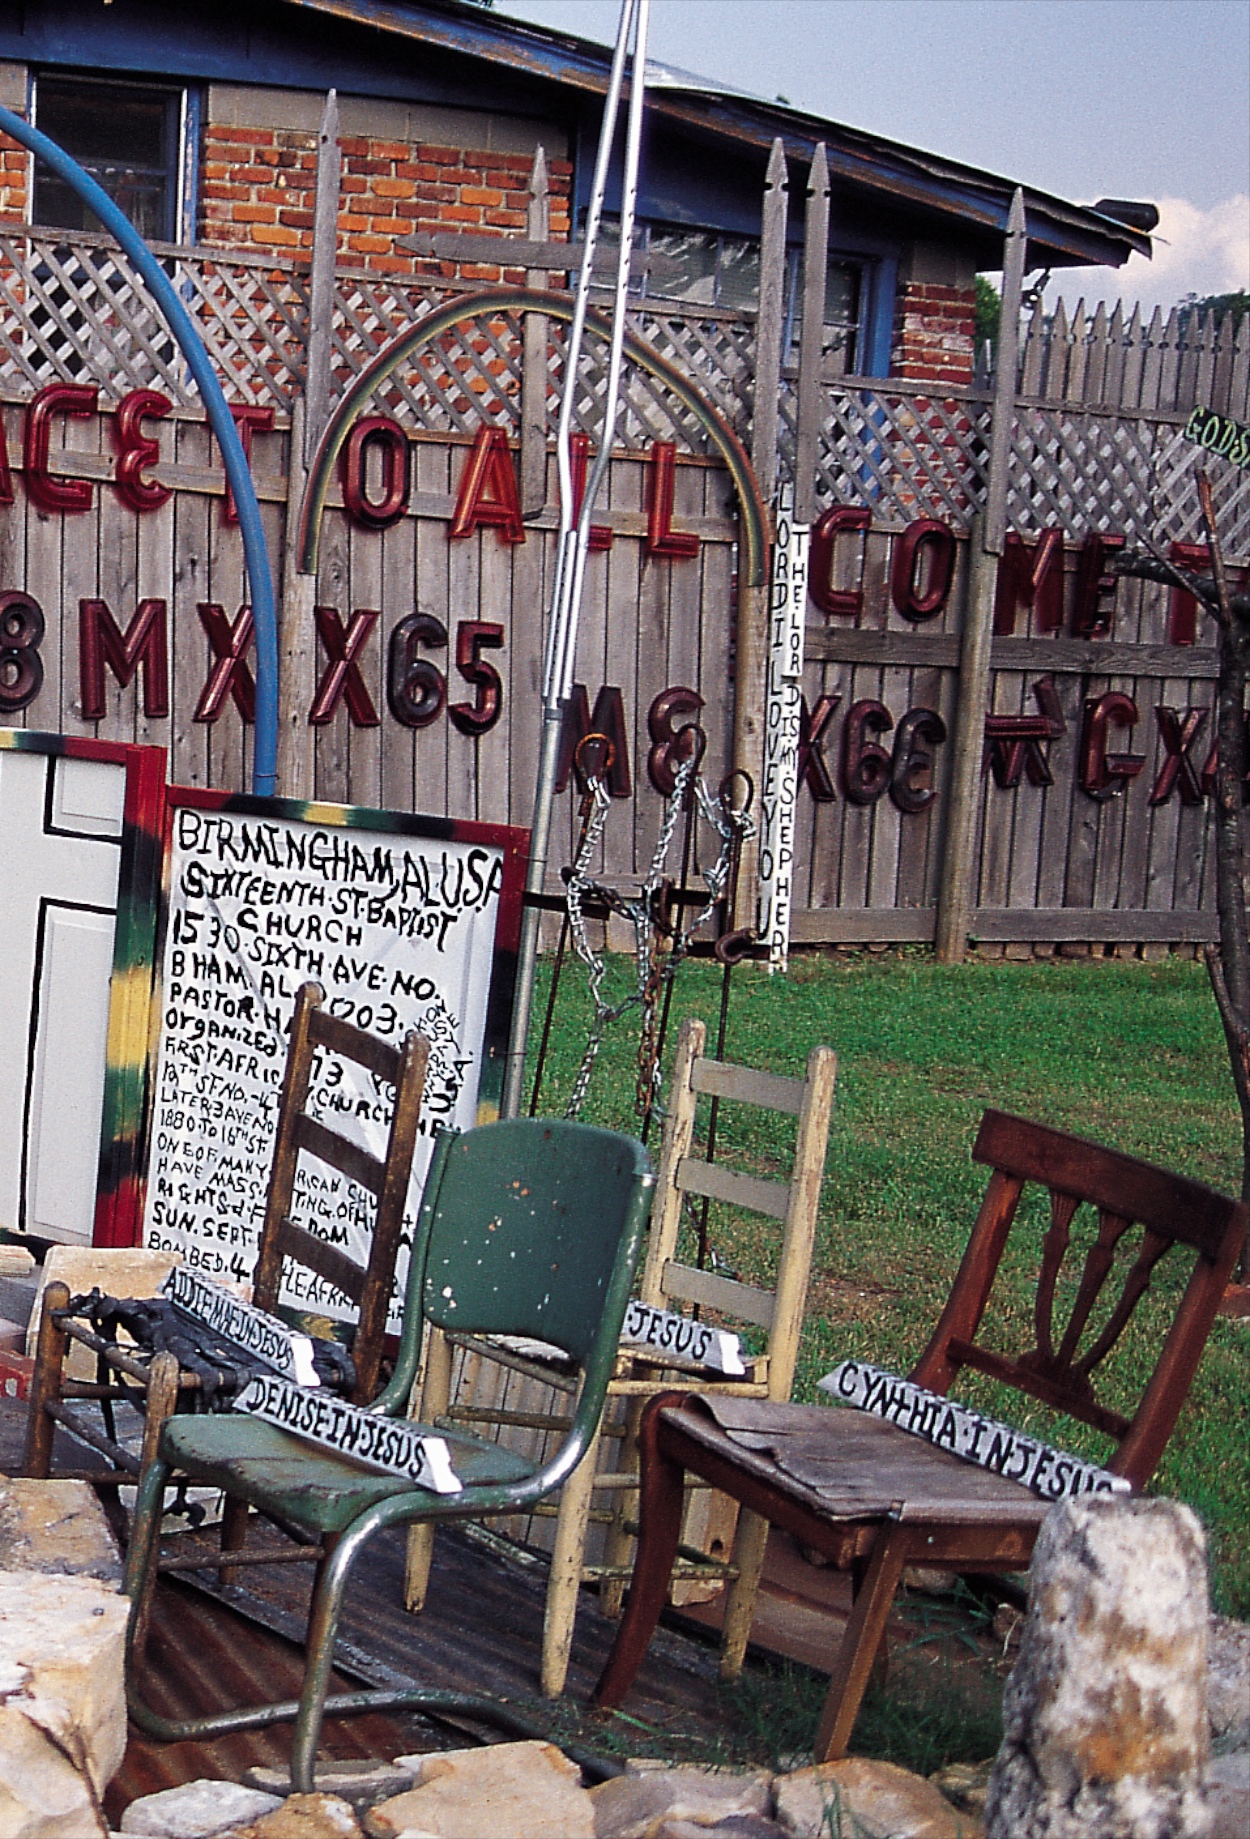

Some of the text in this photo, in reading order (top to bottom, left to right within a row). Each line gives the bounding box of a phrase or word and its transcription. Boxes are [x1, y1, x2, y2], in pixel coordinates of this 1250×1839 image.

[1186, 405, 1236, 454] GOD
[791, 530, 809, 604] THE
[181, 861, 324, 910] SIXTEENTH
[366, 898, 458, 952] BAPTIST
[237, 908, 363, 946] CHURCH
[173, 908, 240, 953] 1530
[248, 937, 323, 975] SIXTH
[171, 983, 254, 1023] PASTOR
[157, 1132, 194, 1158] ONE
[160, 1108, 196, 1132] 1880
[157, 1157, 204, 1180] HAVE
[630, 1307, 712, 1360] JESUS
[250, 1377, 328, 1438] DENISE
[361, 1416, 427, 1477] JESUS
[838, 1362, 956, 1448] CYNTHIA
[965, 1421, 1014, 1477] IN
